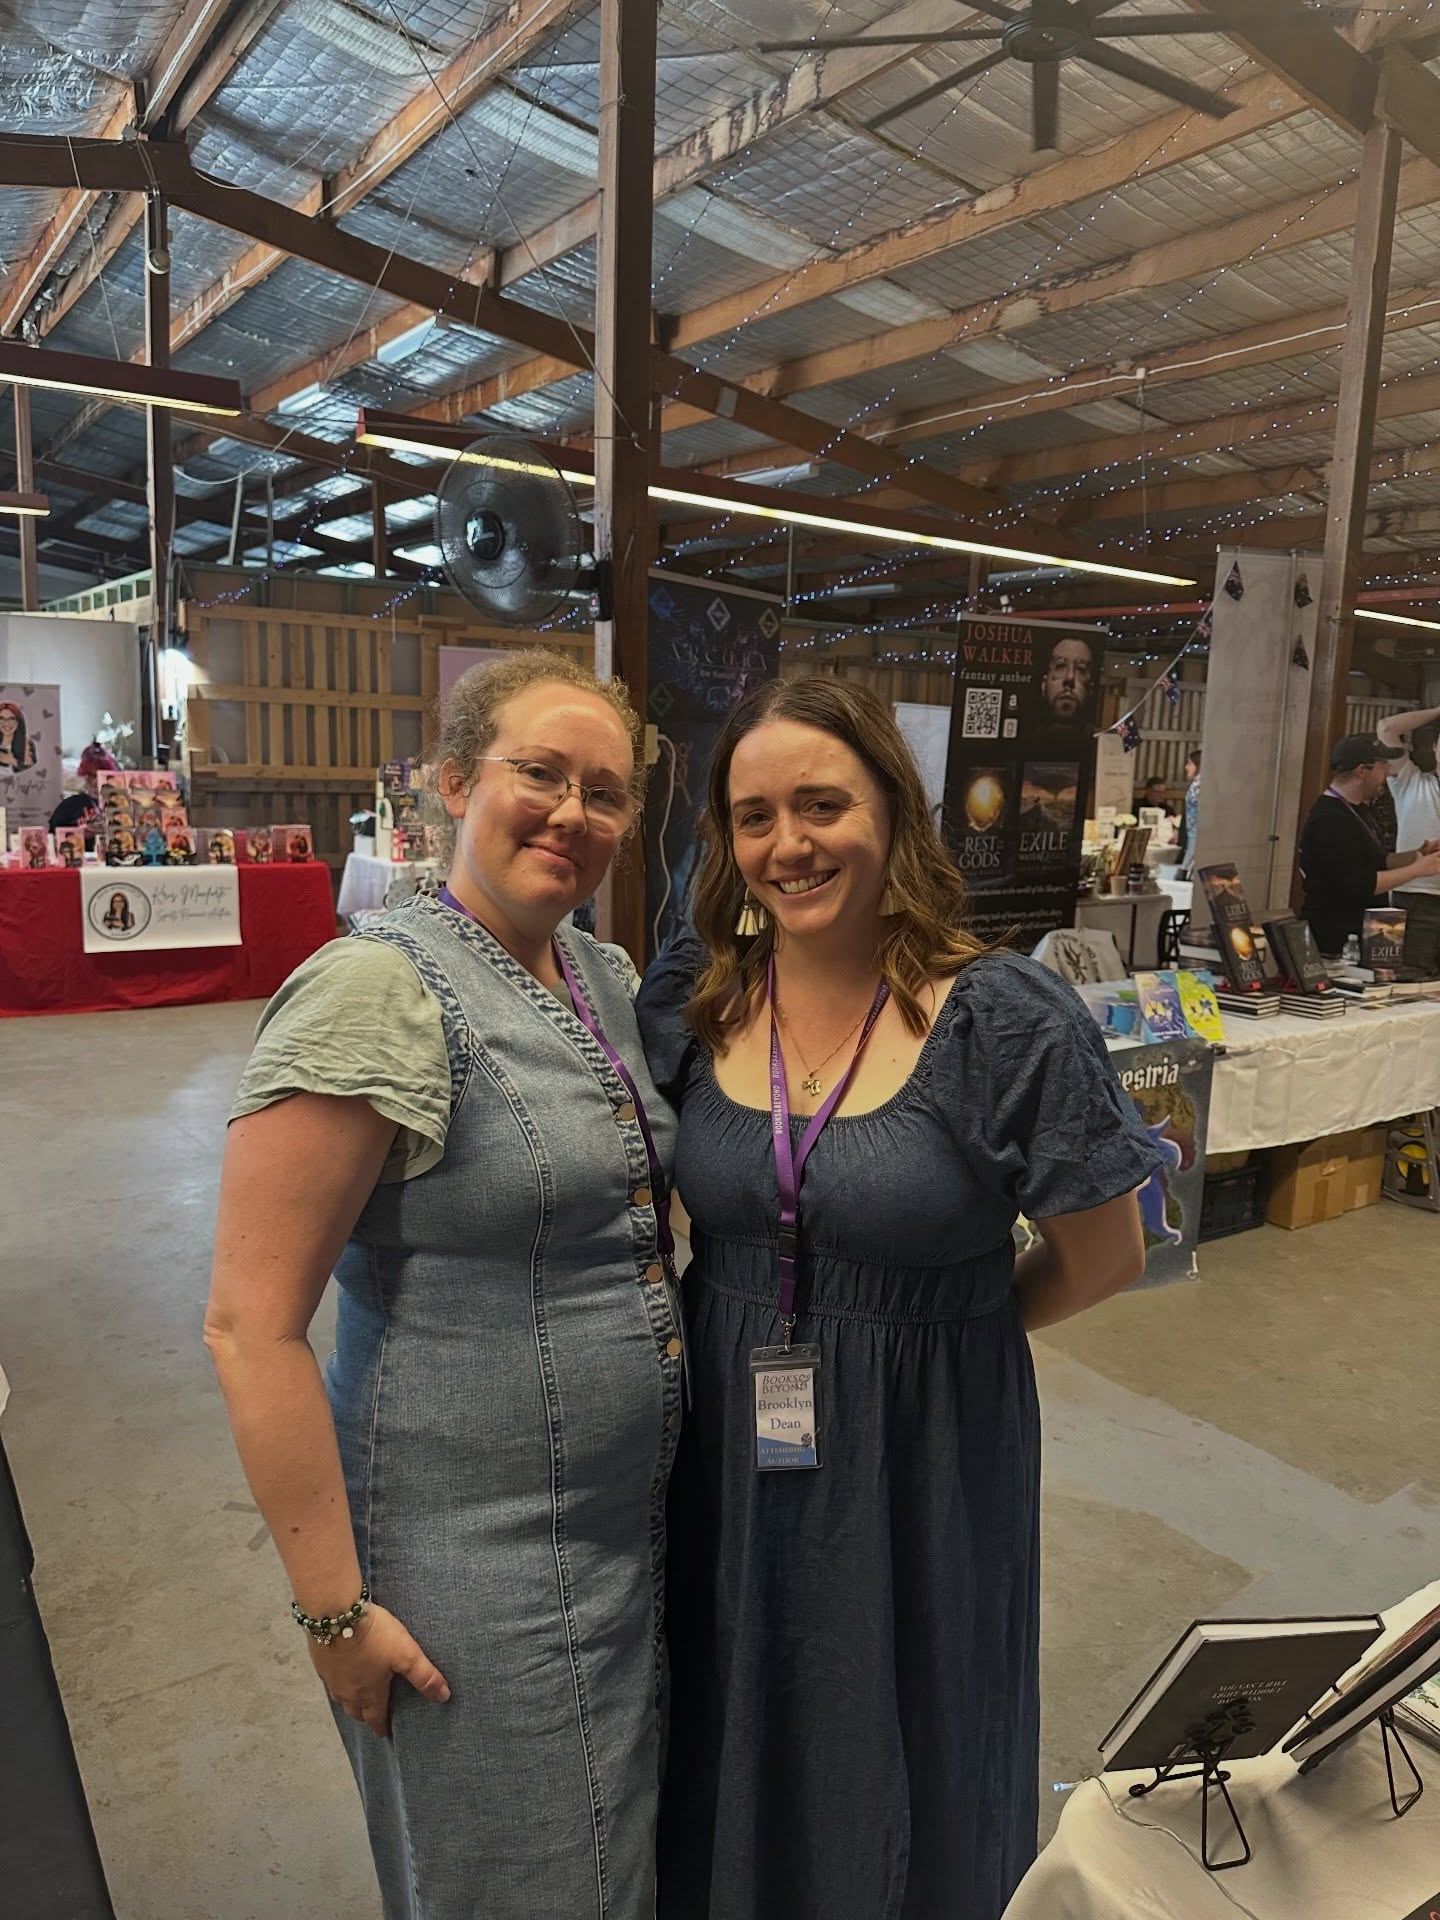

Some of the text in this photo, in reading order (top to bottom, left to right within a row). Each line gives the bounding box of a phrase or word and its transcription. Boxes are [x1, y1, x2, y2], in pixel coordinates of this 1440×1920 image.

[963, 623, 1033, 644] JOSHUA
[962, 645, 1033, 665] WALKER
[960, 668, 1032, 685] fantasy author
[964, 835, 998, 853] REST
[1019, 832, 1069, 852] EXILE
[958, 851, 1001, 869] GODS
[1371, 946, 1402, 958] EXILE
[1117, 1057, 1180, 1092] estria
[763, 1375, 797, 1385] BOOKS
[763, 1383, 808, 1394] BEYOND
[758, 1397, 812, 1411] Brooklyn
[770, 1417, 801, 1430] Dean
